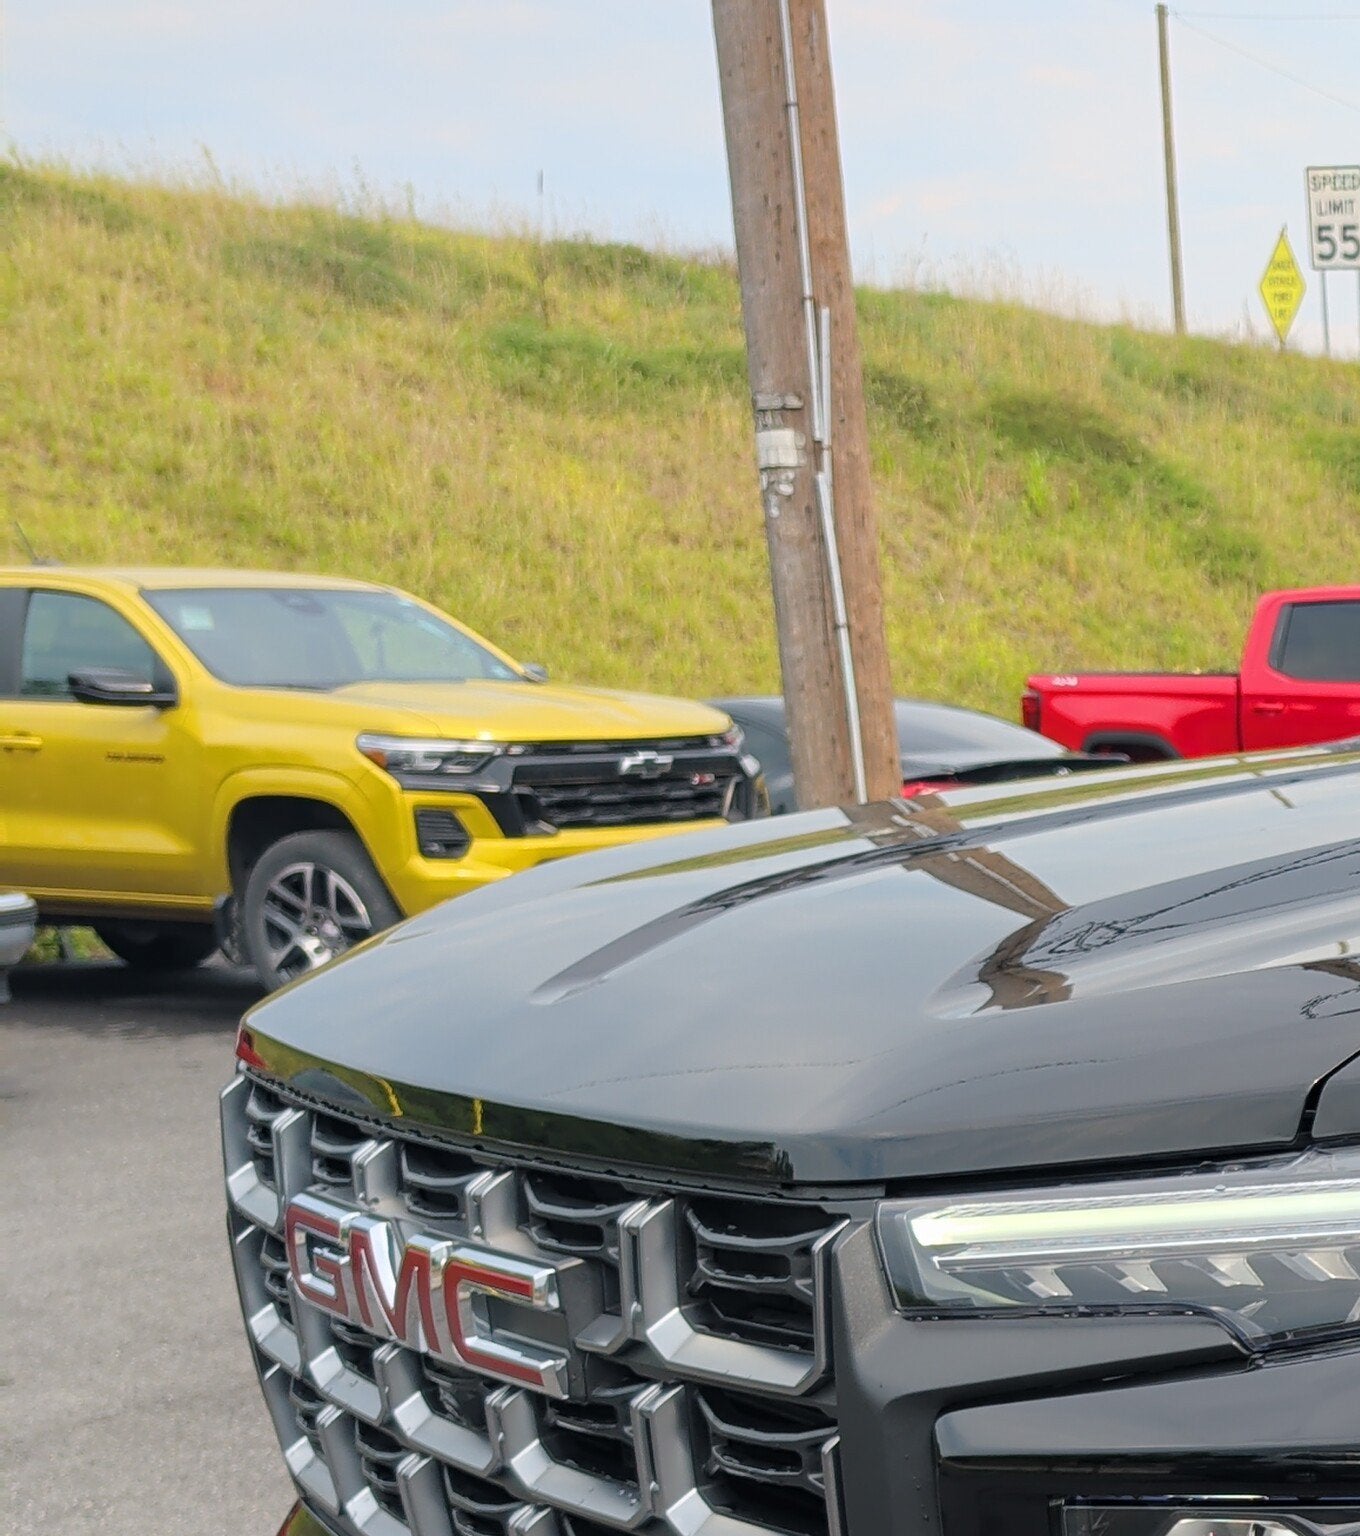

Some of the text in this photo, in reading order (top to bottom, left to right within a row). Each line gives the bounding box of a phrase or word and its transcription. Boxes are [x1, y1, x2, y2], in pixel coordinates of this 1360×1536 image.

[1311, 174, 1360, 192] SPEED
[1316, 199, 1355, 217] LIMIT
[285, 1192, 571, 1400] GMC
